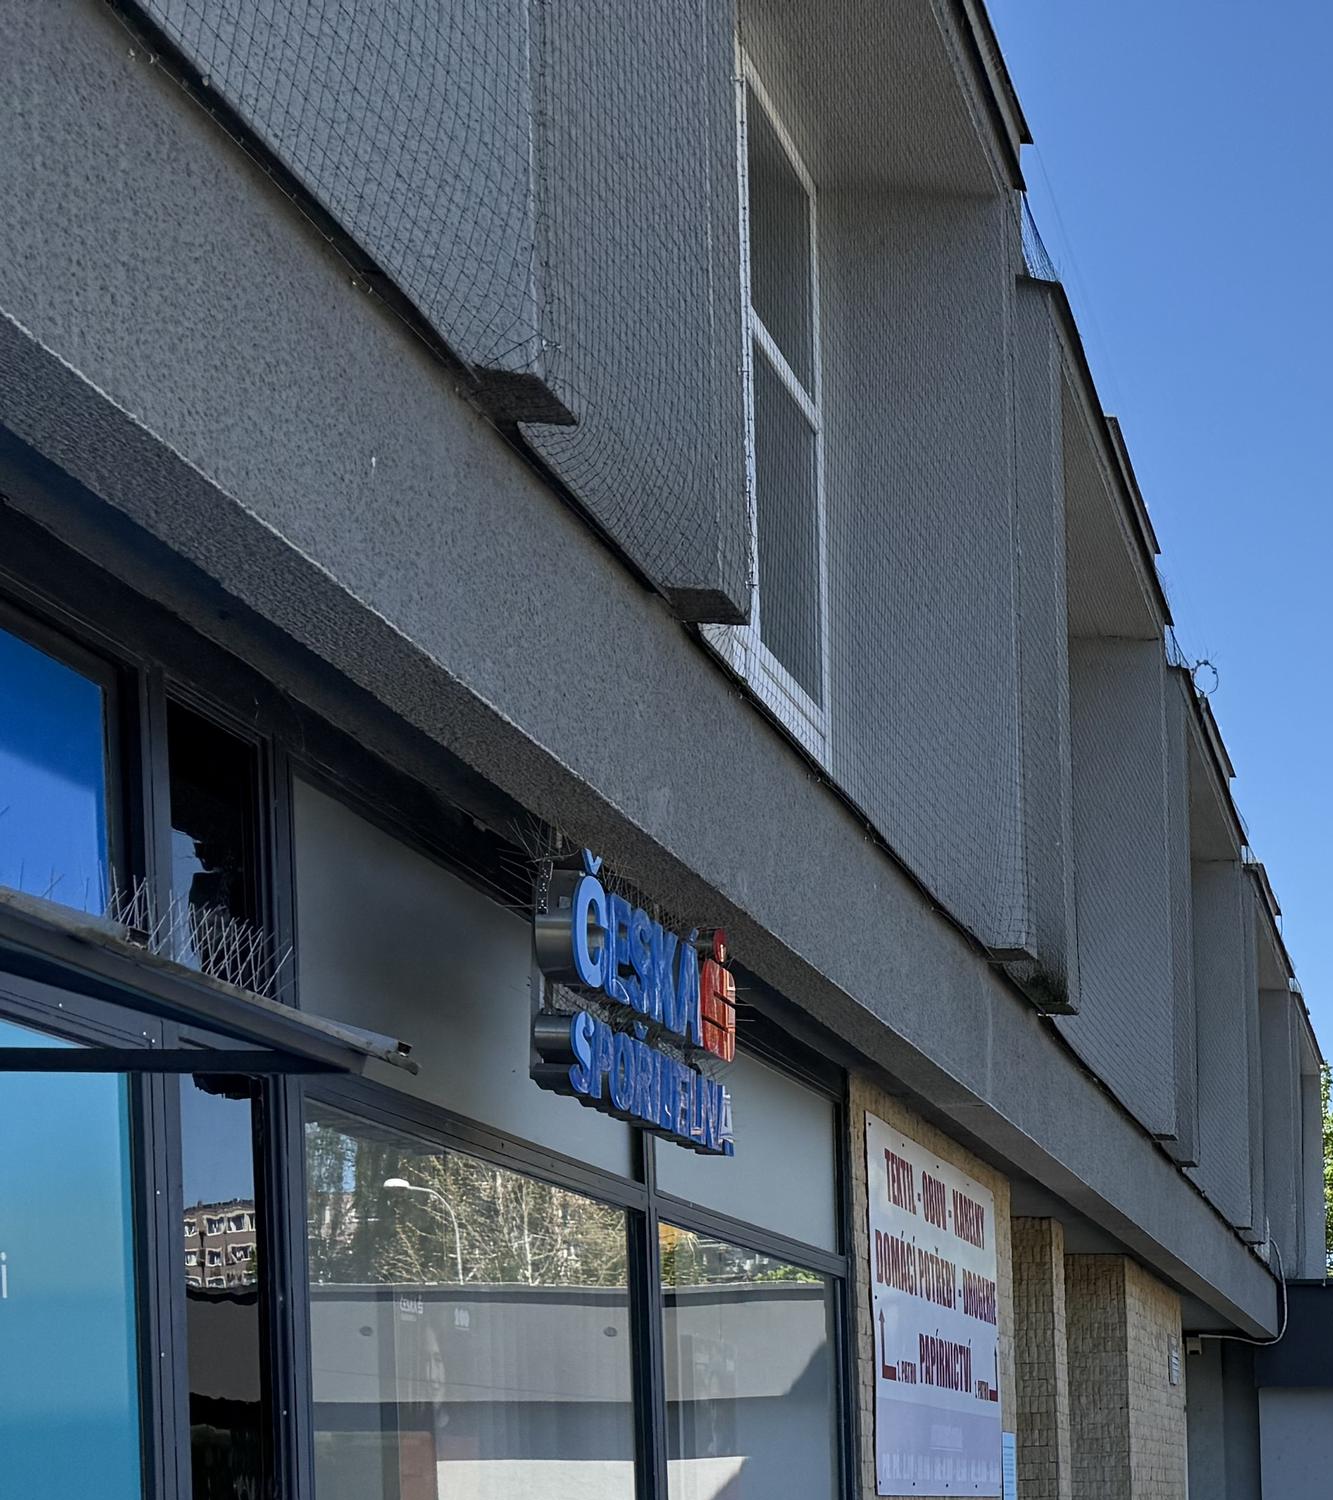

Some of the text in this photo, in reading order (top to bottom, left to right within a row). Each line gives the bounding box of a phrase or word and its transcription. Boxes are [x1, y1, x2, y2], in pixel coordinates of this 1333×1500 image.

[571, 848, 704, 1048] ČESKÁ
[884, 1147, 917, 1216] TEXTIL
[921, 1170, 947, 1231] OBUV
[952, 1188, 985, 1251] KABELKY
[874, 1230, 918, 1296] DOMÁCÍ
[918, 1245, 957, 1311] POTŘEBY
[962, 1267, 997, 1326] DROGERIE
[918, 1328, 972, 1393] PAPÍRNICTVÍ
